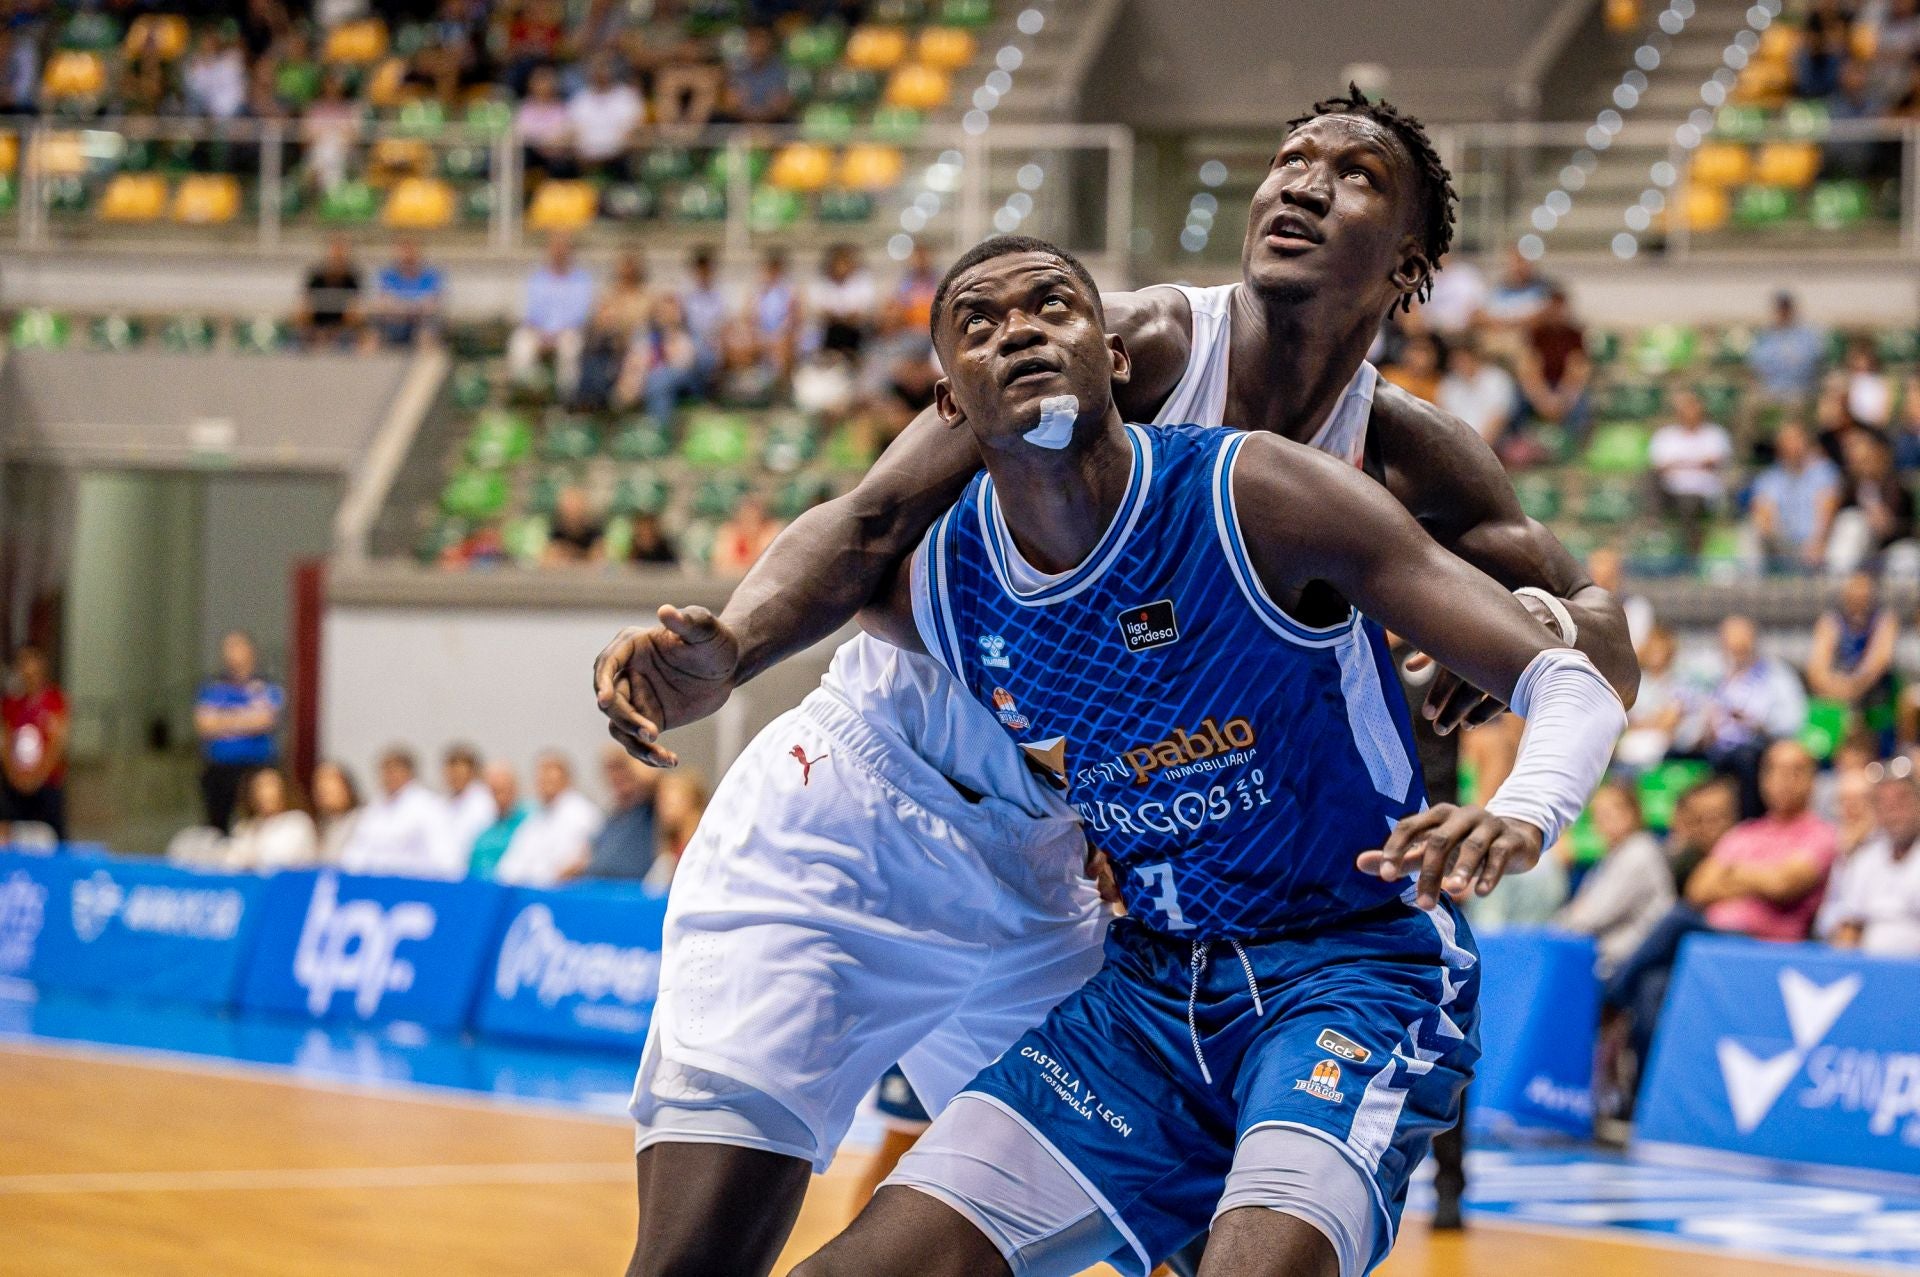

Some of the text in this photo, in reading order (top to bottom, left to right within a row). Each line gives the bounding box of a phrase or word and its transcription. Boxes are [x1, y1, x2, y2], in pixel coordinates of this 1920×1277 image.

[1127, 621, 1148, 635] liga
[1131, 628, 1174, 645] endesa
[1164, 748, 1257, 781] INMOBILIARIA
[1322, 1039, 1355, 1059] acb
[1020, 1046, 1133, 1138] CASTILLA Y LEÓN
[1040, 1071, 1093, 1120] NOS IMPULSA
[1300, 1082, 1341, 1100] BURGOS
